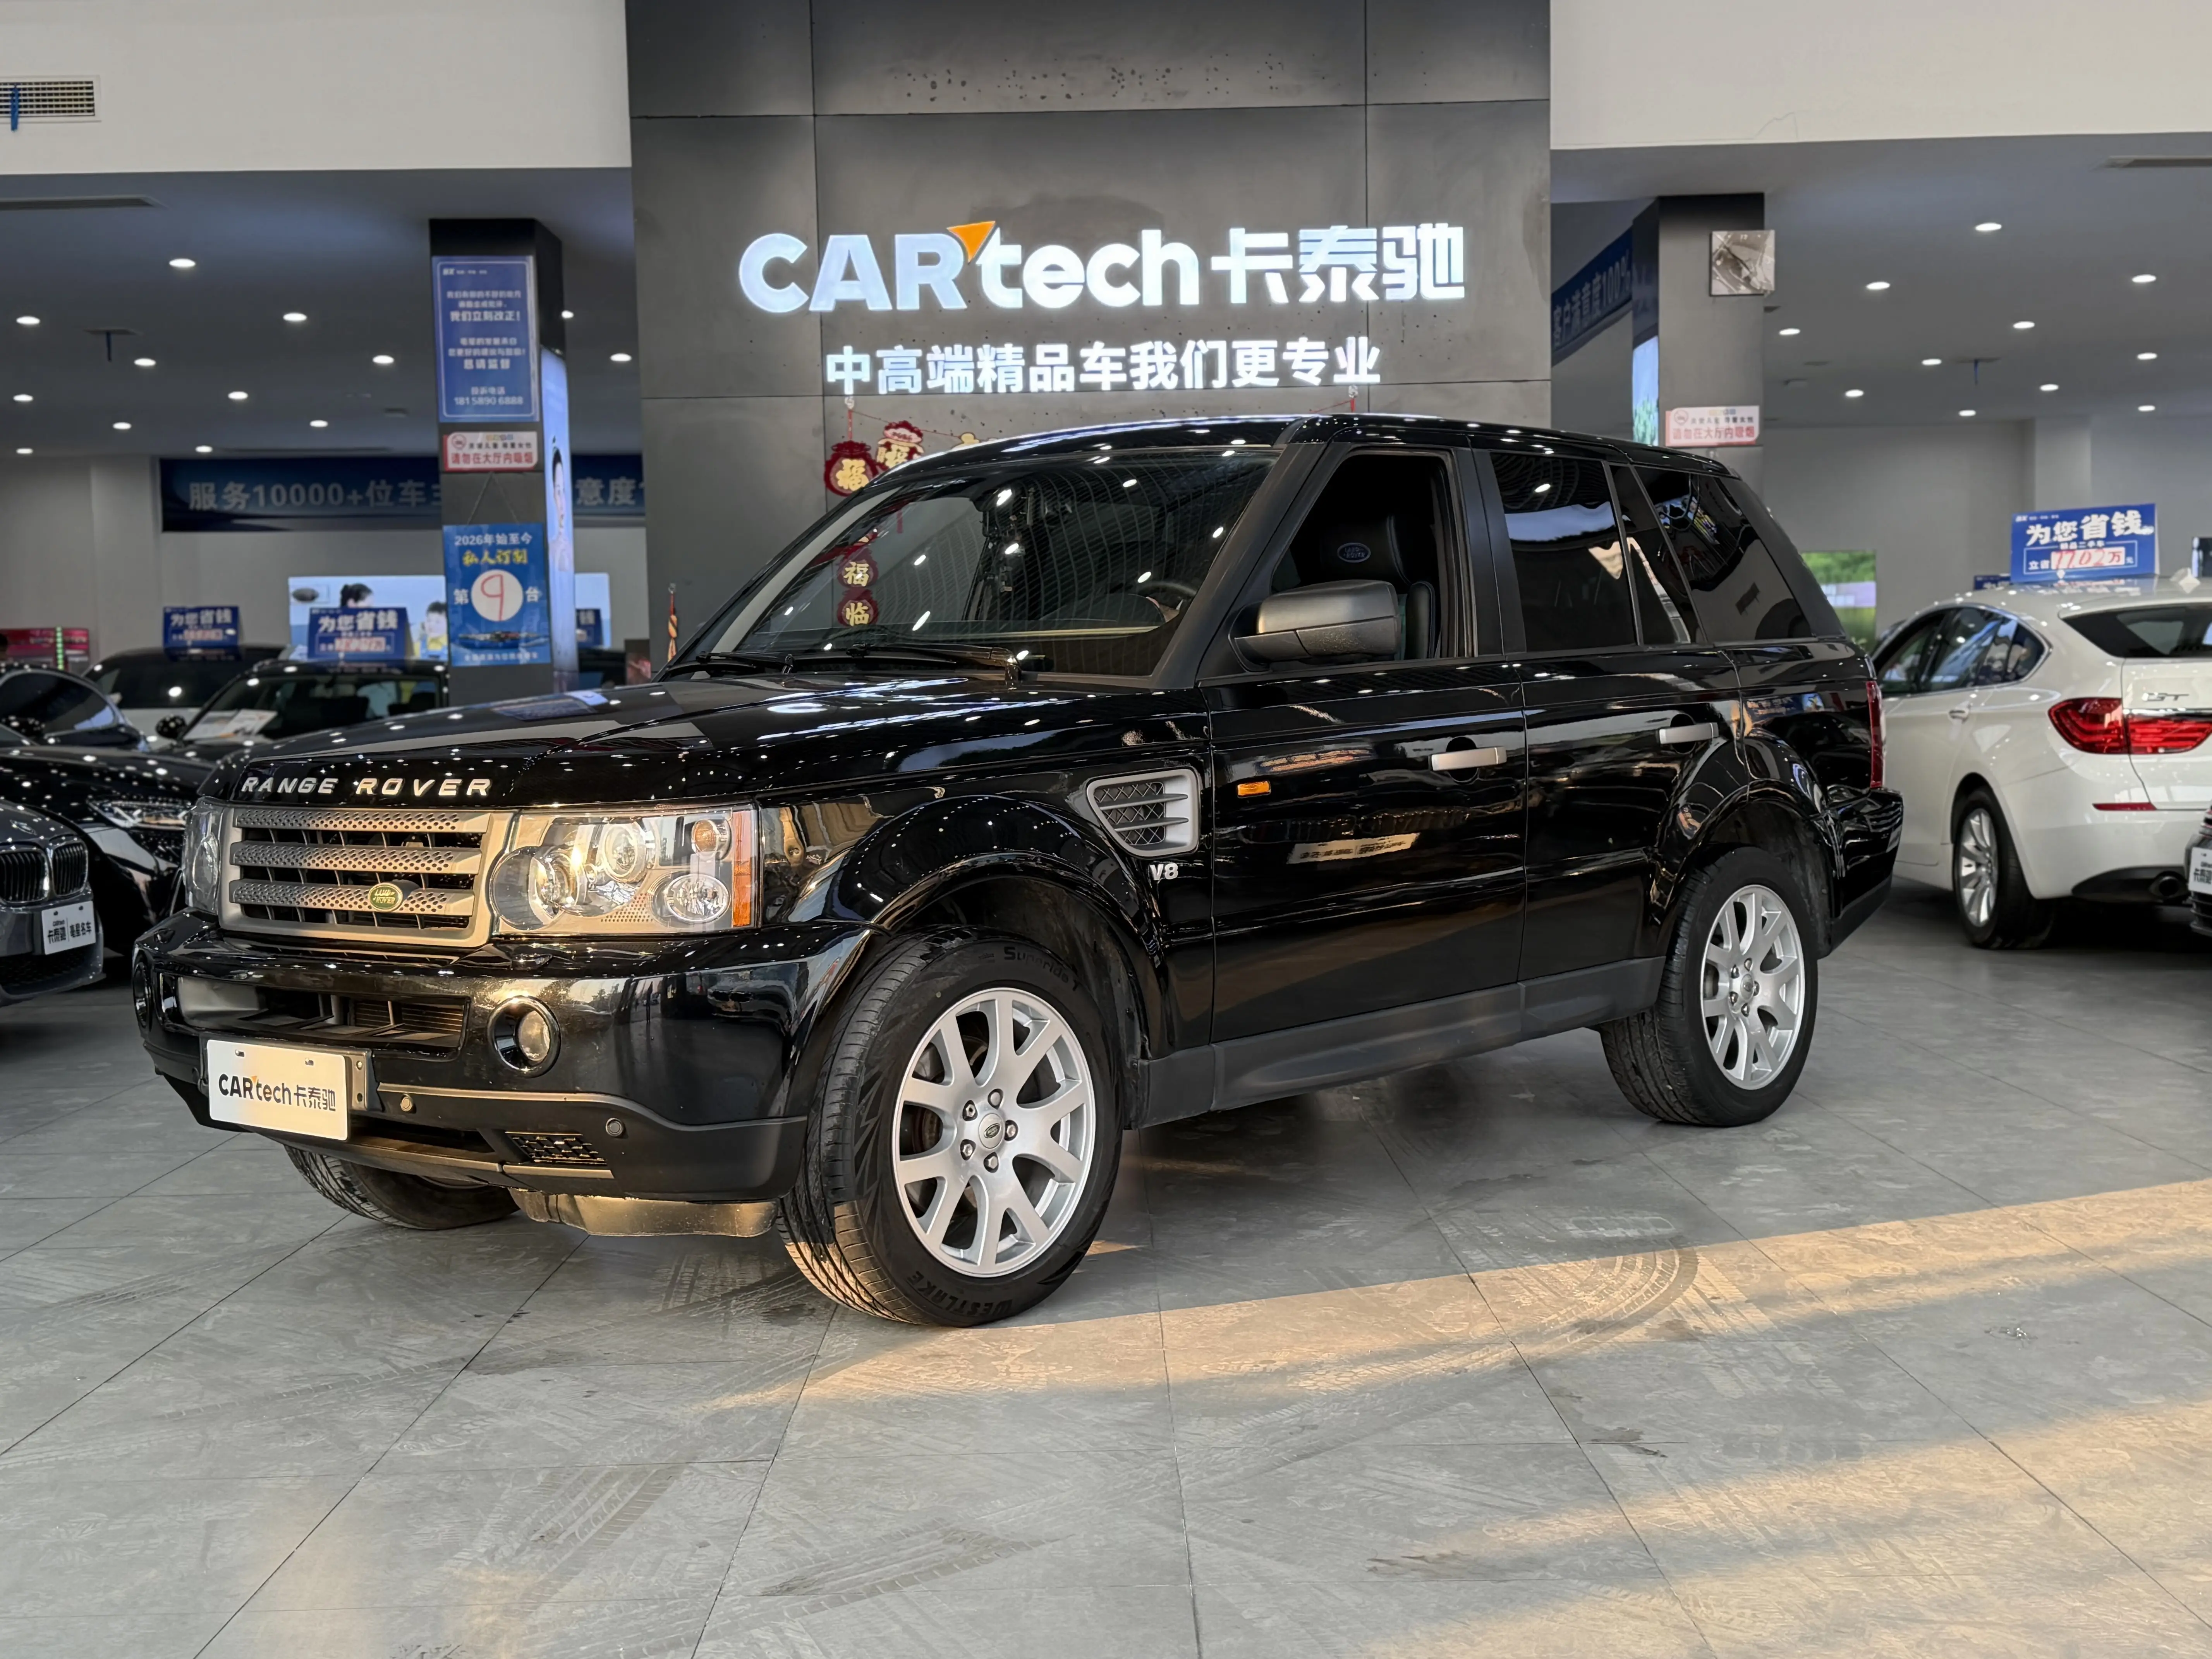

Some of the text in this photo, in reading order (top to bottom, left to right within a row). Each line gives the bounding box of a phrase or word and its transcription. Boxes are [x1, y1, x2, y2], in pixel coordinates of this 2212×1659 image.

[739, 223, 1465, 313] CARtech 卡泰驰
[825, 336, 1381, 395] 中高端精品车我们更专业
[836, 459, 870, 491] 福
[454, 532, 532, 546] 2026年始至今
[2026, 510, 2142, 547] 为您省钱
[462, 549, 527, 566] 私人订制
[453, 589, 469, 605] 第
[526, 586, 539, 603] 台
[241, 777, 491, 796] RANGE ROVER
[1149, 862, 1179, 881] V8
[218, 1073, 336, 1111] CARtech 卡泰驰
